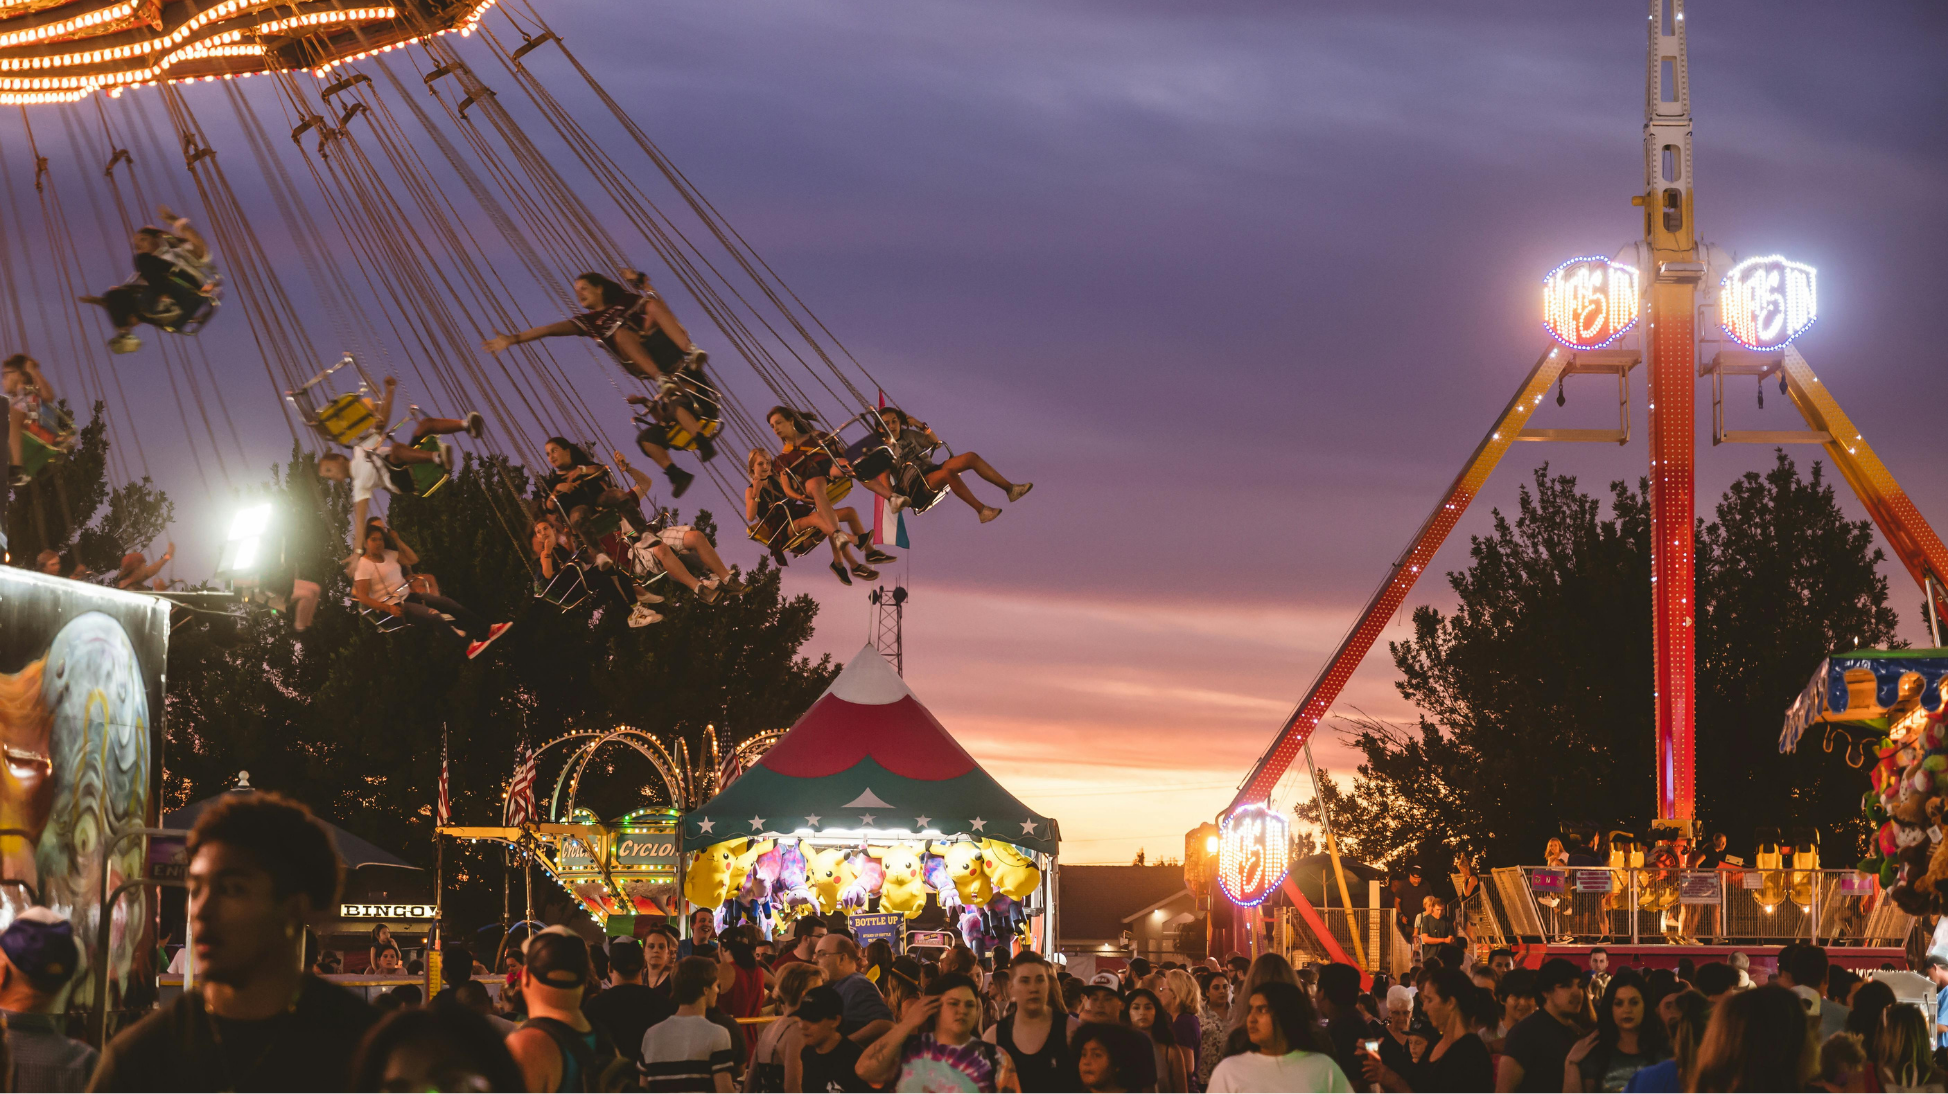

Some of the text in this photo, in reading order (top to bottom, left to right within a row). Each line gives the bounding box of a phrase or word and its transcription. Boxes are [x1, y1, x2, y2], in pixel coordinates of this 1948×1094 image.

[344, 905, 425, 917] BINGO
[855, 915, 898, 927] BOTTLE UP
